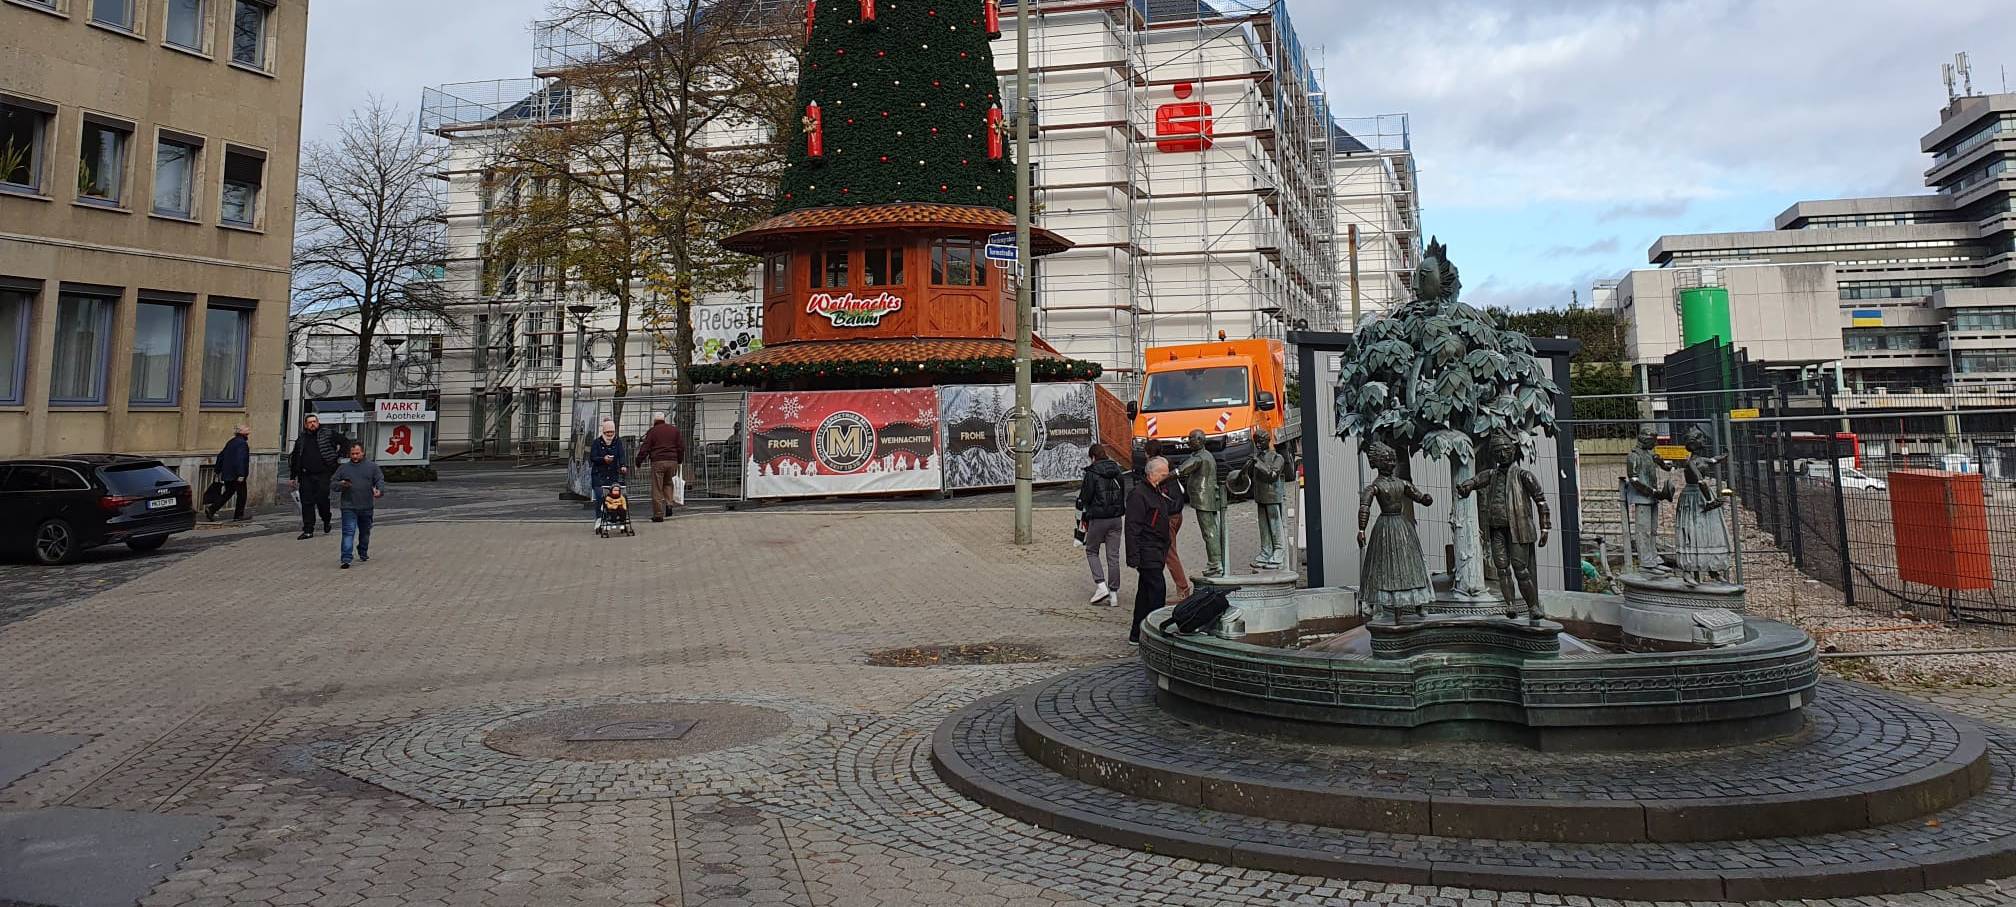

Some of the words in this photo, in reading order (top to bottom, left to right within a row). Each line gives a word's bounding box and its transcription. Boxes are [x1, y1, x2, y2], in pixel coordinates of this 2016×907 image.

[807, 292, 901, 312] Weihnachts
[830, 310, 879, 326] Baum
[381, 402, 420, 411] MARKT
[386, 412, 426, 420] Apotheke
[960, 431, 986, 440] FROHE
[1049, 428, 1089, 436] WEIHNACHTEN
[767, 439, 799, 449] FROHE
[827, 425, 862, 456] M
[880, 435, 931, 444] WEIHNACHTEN
